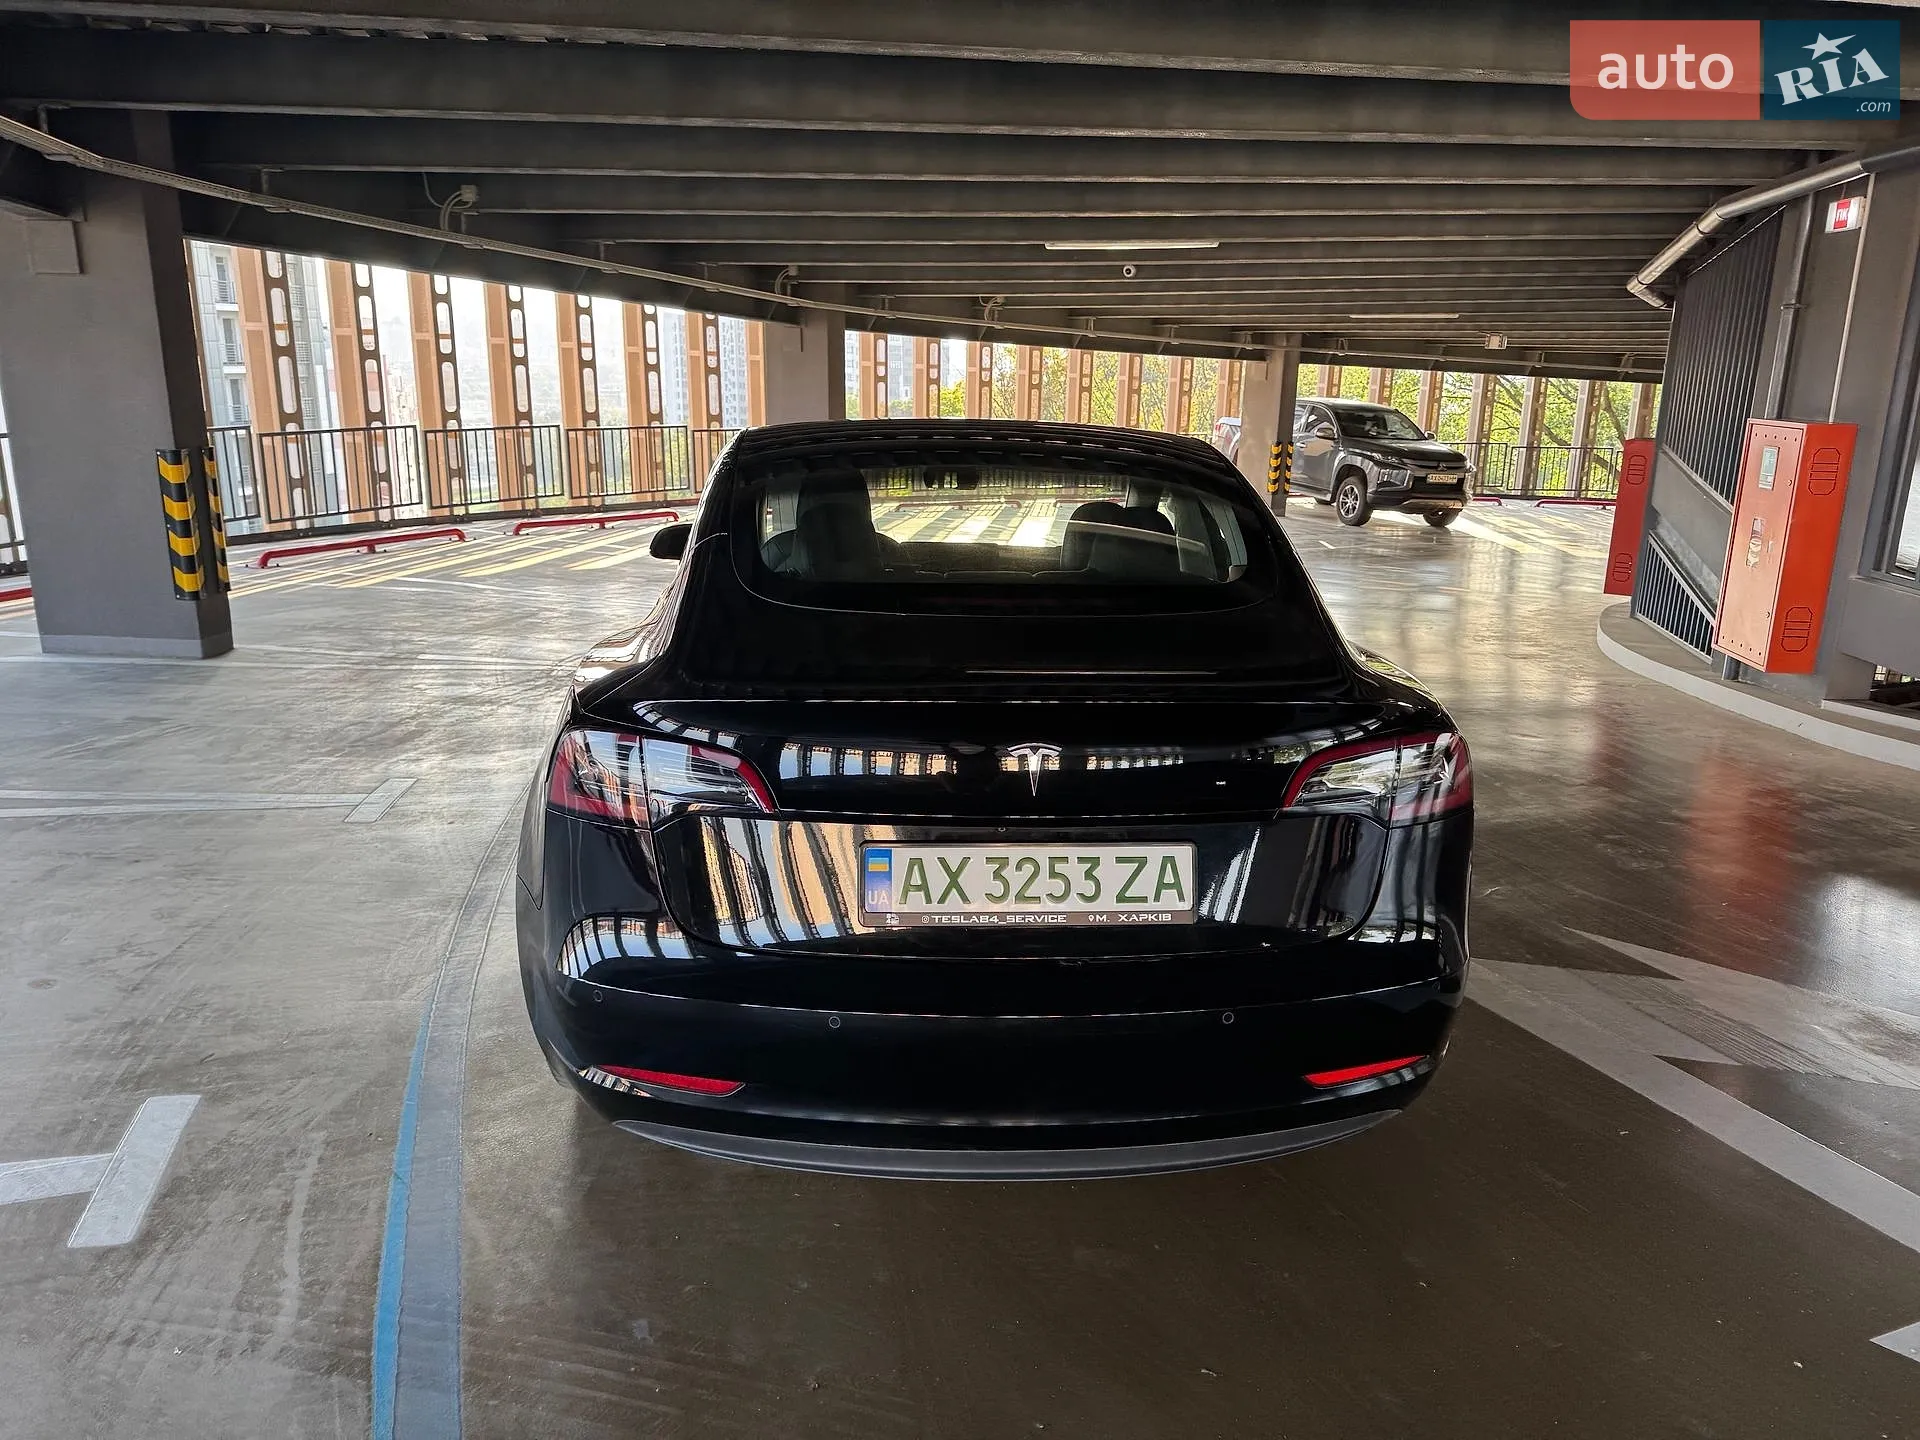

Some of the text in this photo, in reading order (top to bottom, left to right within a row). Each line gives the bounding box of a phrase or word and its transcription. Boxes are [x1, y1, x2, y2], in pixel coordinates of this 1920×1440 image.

[899, 855, 1186, 905] AX 3253 ZA
[868, 890, 889, 905] UA
